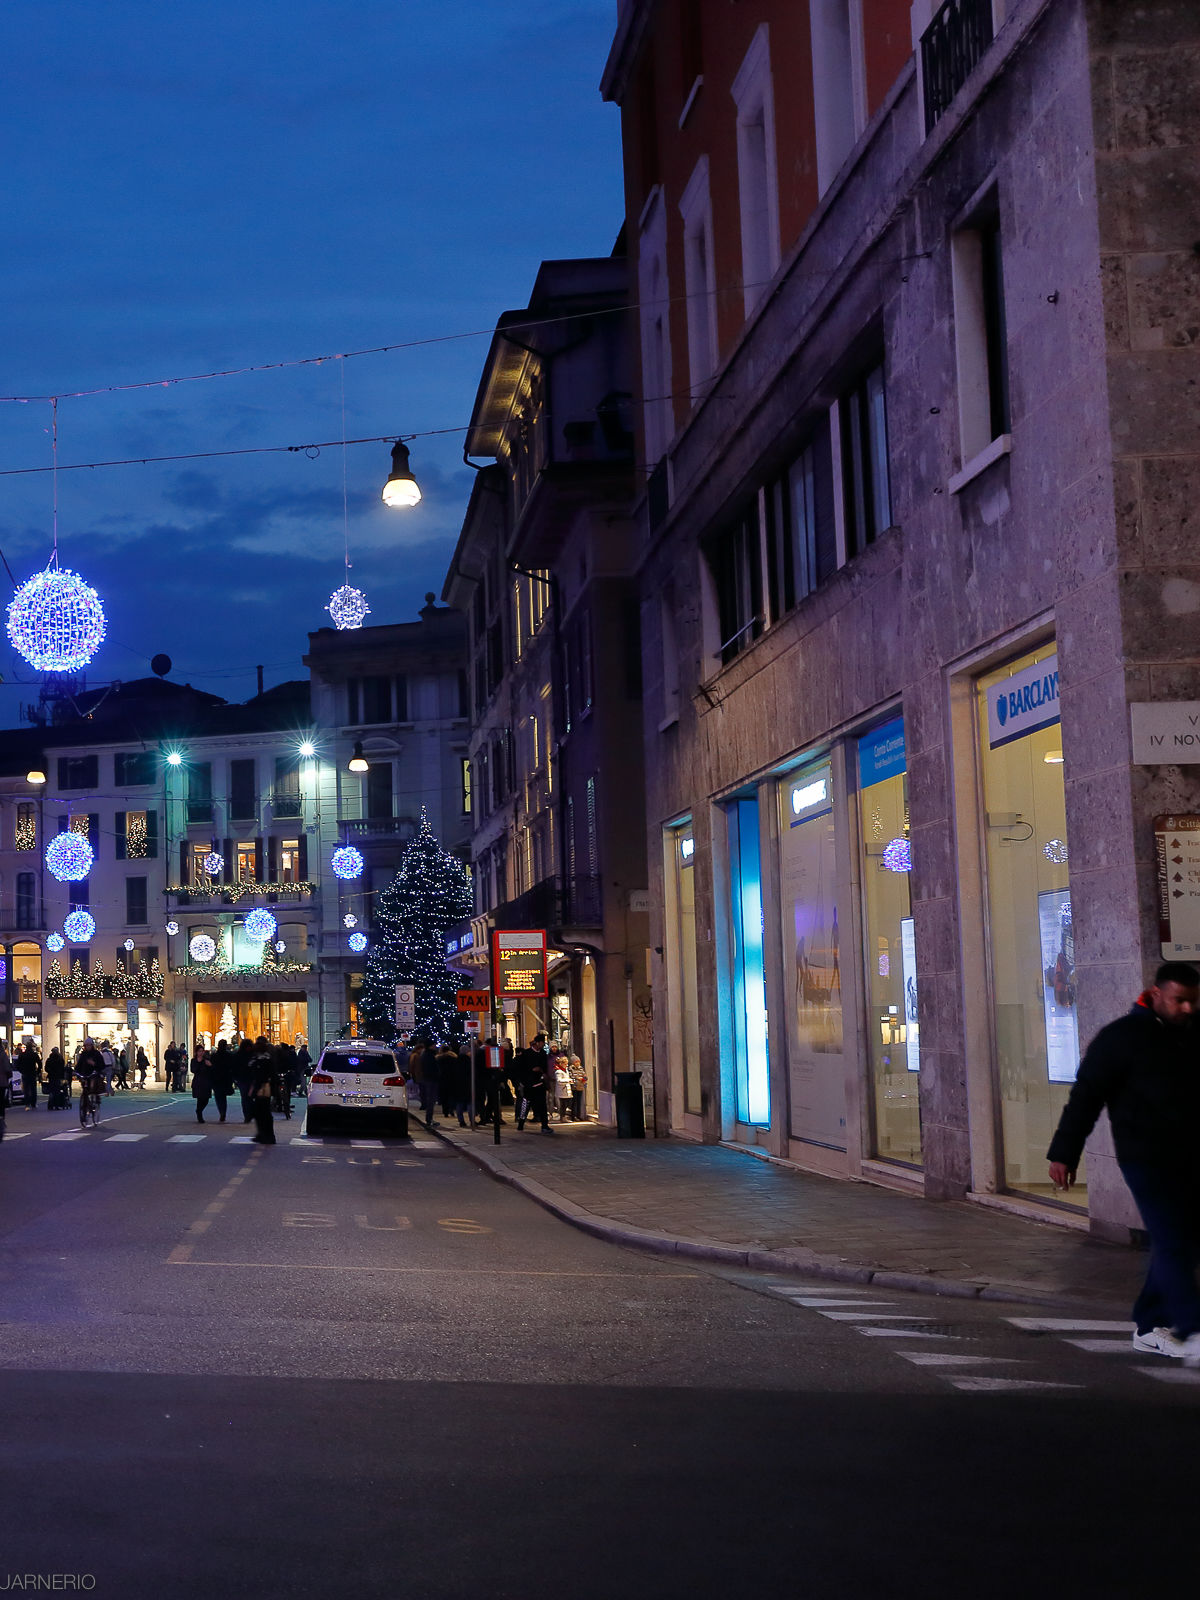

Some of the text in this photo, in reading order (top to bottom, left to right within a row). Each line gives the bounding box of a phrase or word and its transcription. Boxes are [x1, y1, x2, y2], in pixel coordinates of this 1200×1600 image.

[1009, 671, 1060, 718] BARCLAY
[1150, 735, 1164, 746] IV
[500, 950, 511, 960] 12
[197, 974, 298, 985] CAPRETTINI
[459, 995, 488, 1007] TAXI
[281, 1211, 495, 1235] BUS
